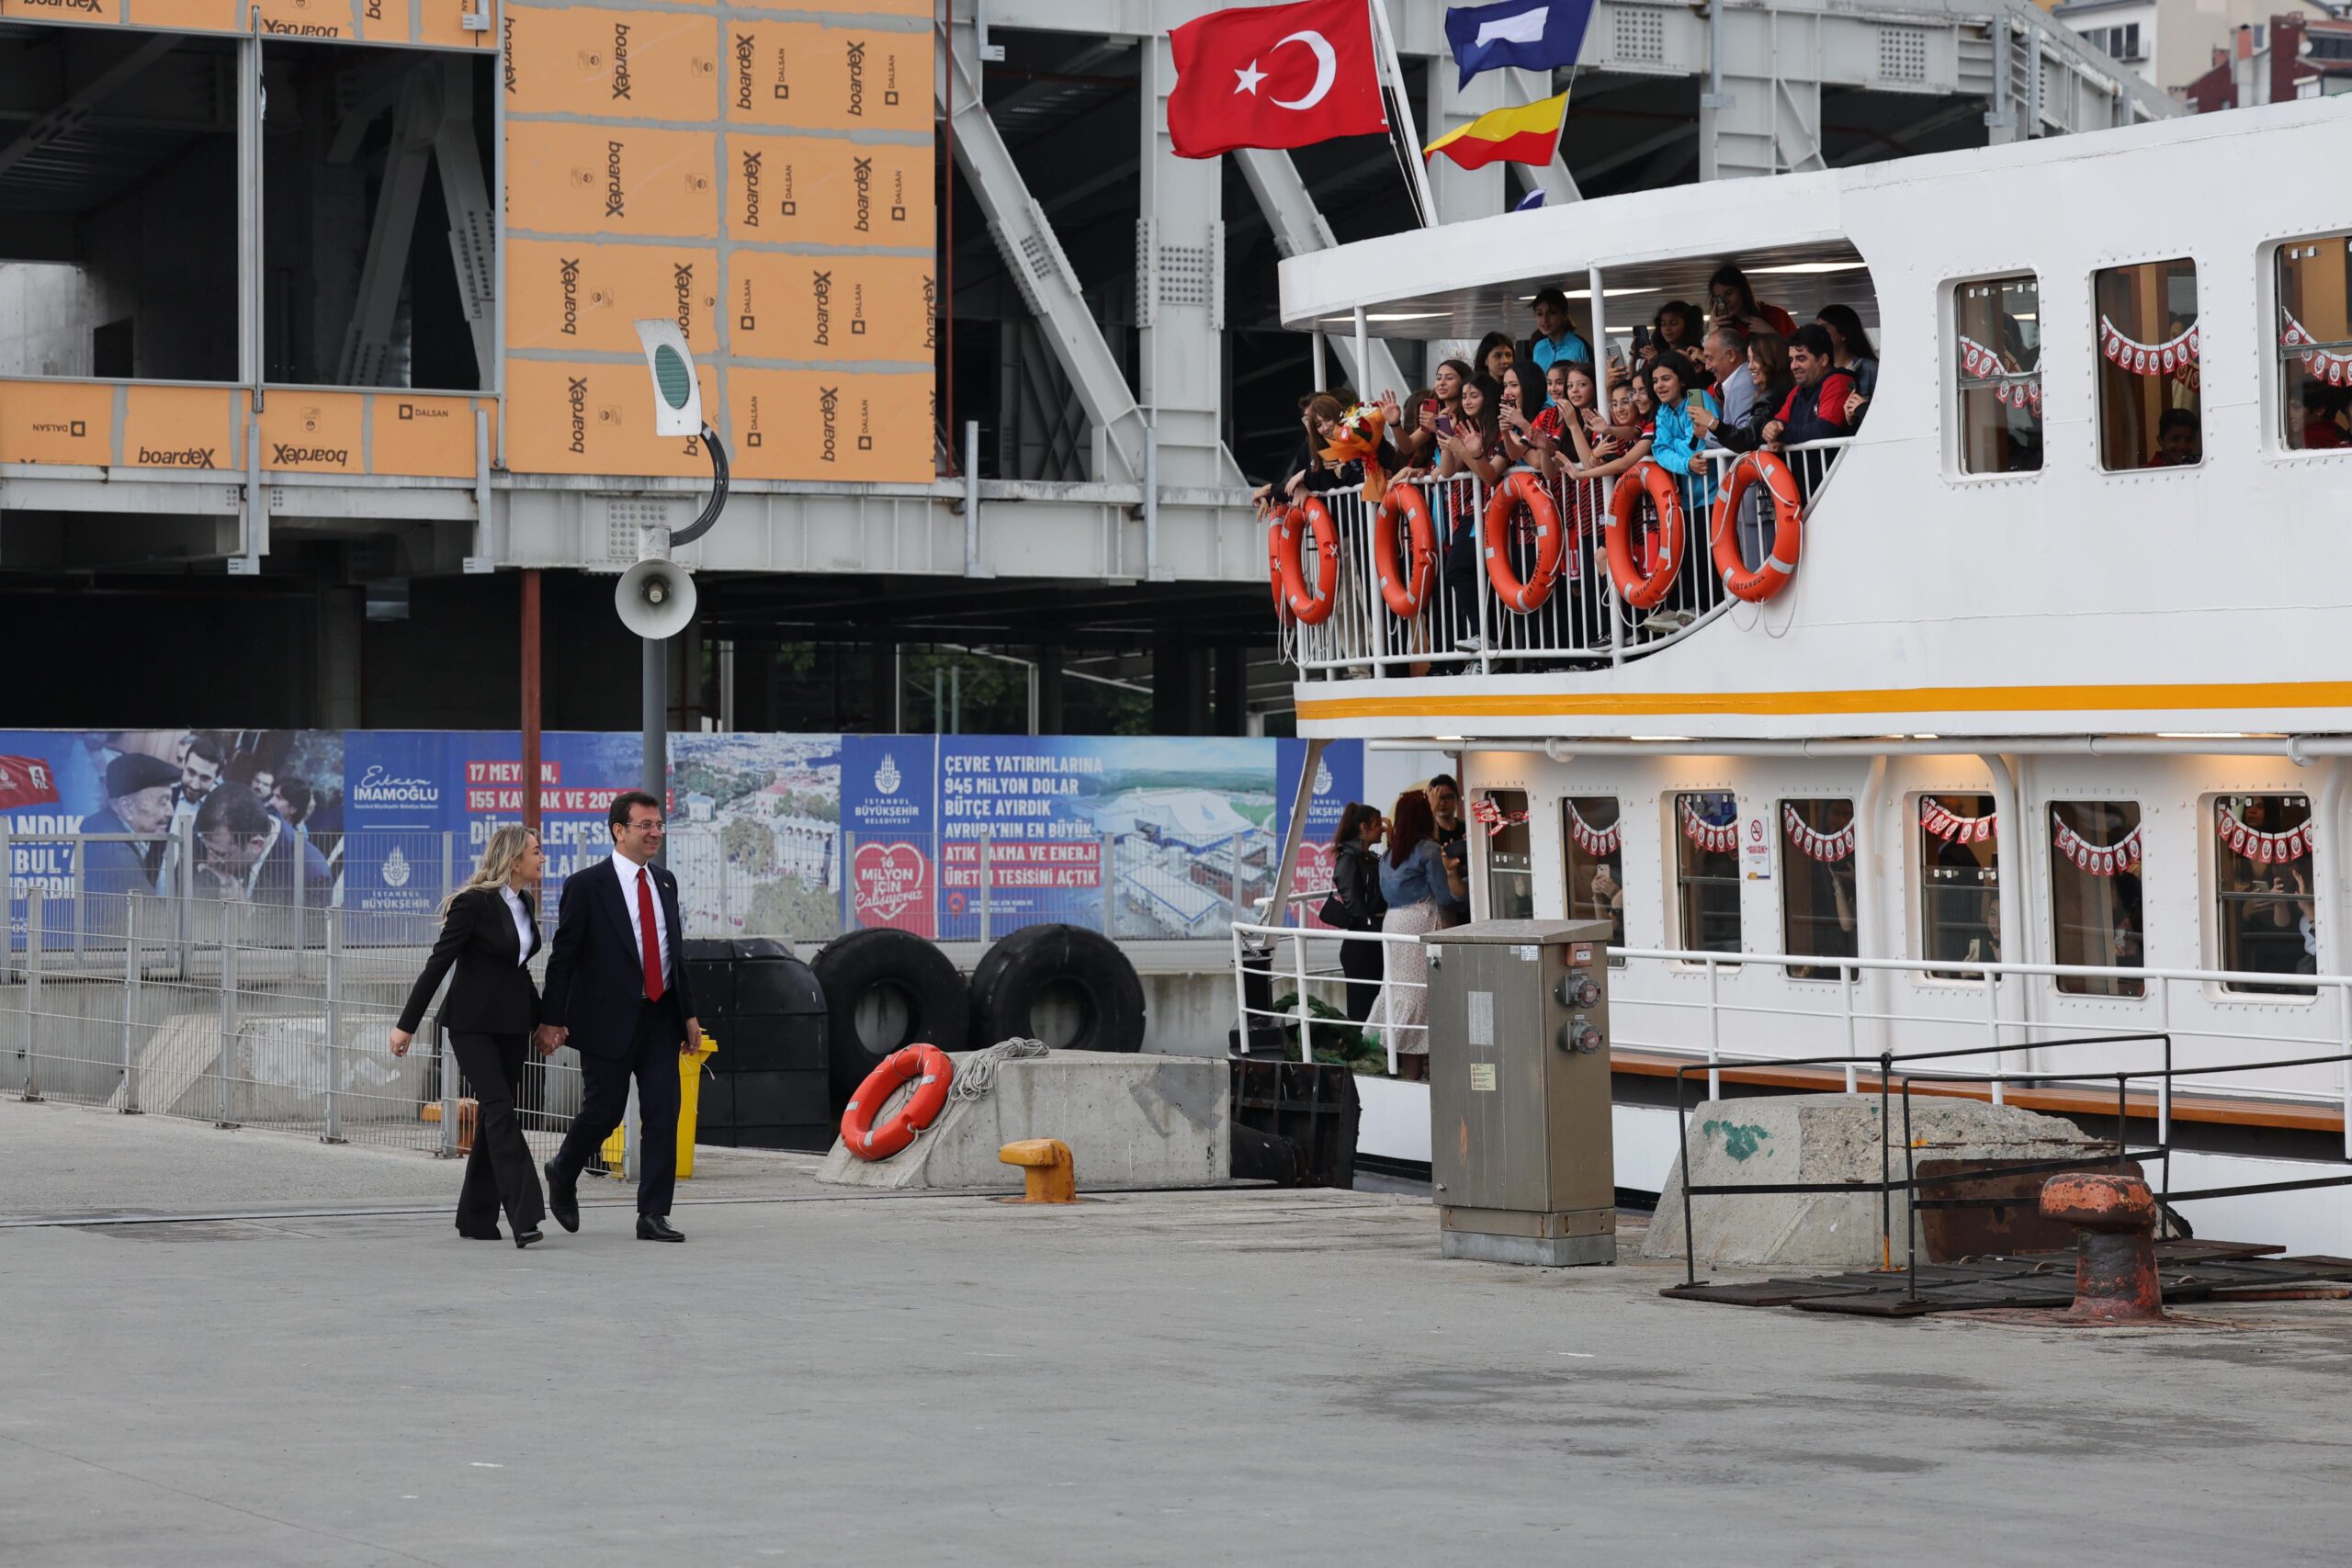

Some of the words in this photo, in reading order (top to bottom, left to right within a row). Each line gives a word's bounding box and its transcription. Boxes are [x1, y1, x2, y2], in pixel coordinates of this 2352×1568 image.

[24, 0, 103, 13] ardeX
[612, 23, 630, 100] boardeX
[735, 34, 754, 110] boardeX
[847, 40, 865, 117] boardeX
[605, 141, 624, 218] boardeX
[743, 151, 762, 227] boardeX
[854, 157, 872, 232] boardeX
[560, 258, 580, 335] boardeX
[813, 270, 831, 345] boardeX
[415, 409, 448, 418] DALSAN
[569, 377, 587, 454] boardeX
[33, 423, 68, 433] DALSAN
[820, 387, 838, 462] boardeX
[138, 446, 215, 469] boardeX
[273, 444, 348, 467] boardeX
[1733, 574, 1766, 592] İSTANBUL
[469, 764, 485, 781] 17
[490, 763, 557, 784] MEYN,
[944, 756, 990, 776] ÇEVRE
[995, 756, 1102, 773] YATIRIMLARINA
[354, 784, 438, 801] İMAMOĞLU
[944, 778, 973, 795] 945
[977, 778, 1028, 795] MİLYON
[1032, 779, 1079, 795] DOLAR
[469, 791, 495, 808] 155
[500, 791, 560, 808] KAAK
[565, 792, 584, 808] VE
[944, 795, 991, 819] BÜTÇE
[995, 799, 1052, 816] AYIRDIK
[854, 806, 919, 818] BÜYÜKŞEHİR
[1027, 822, 1044, 838] EN
[1048, 818, 1093, 838] BÜYÜK
[9, 849, 75, 874] BUL'
[881, 856, 894, 867] 16
[944, 845, 977, 861] ATIK
[979, 846, 1025, 861] AKMA
[1029, 846, 1046, 861] VE
[1050, 844, 1097, 861] ENERJİ
[1314, 855, 1326, 866] 16
[862, 868, 913, 880] MİLYON
[944, 866, 993, 885] ÜRET
[1057, 869, 1097, 888] AÇTIK
[1296, 867, 1335, 878] MİLYO
